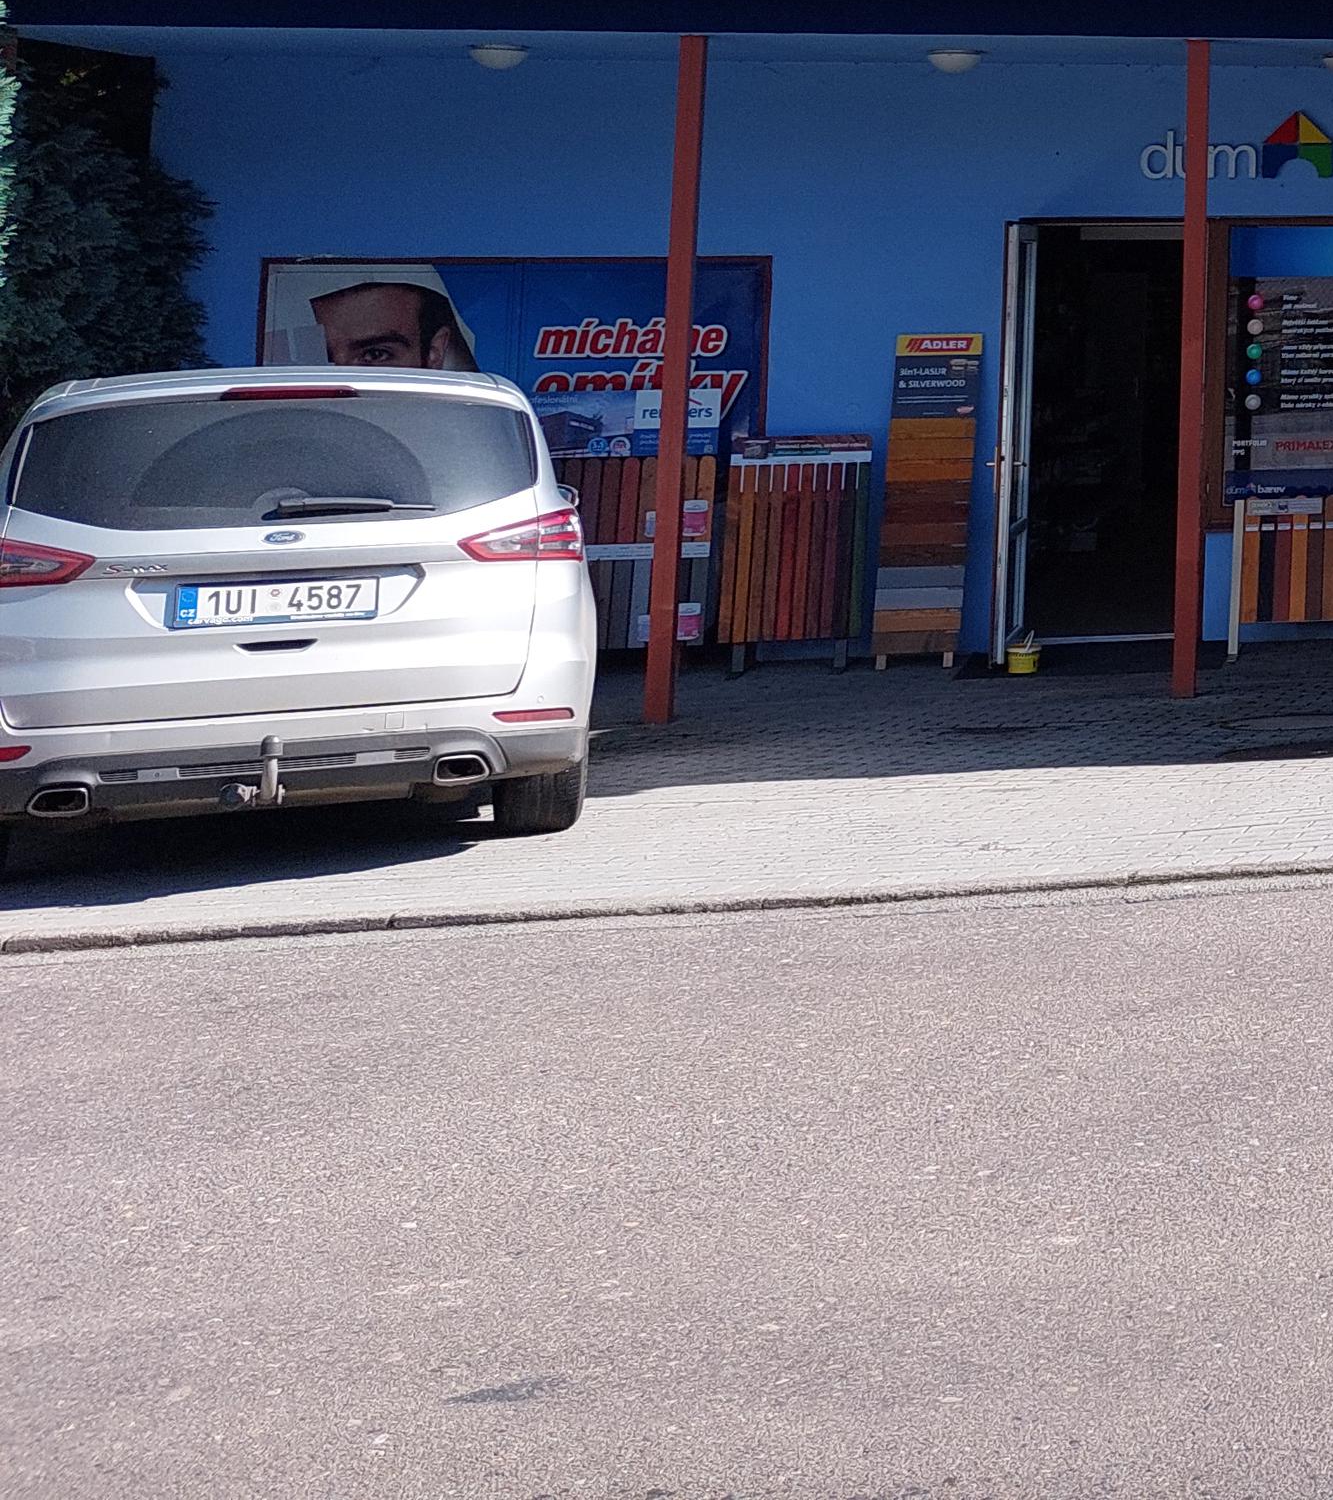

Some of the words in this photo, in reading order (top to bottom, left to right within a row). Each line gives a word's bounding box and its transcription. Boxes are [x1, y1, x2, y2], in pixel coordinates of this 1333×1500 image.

[1141, 131, 1258, 180] dm
[535, 318, 727, 357] mícháe
[920, 340, 968, 349] ADLER
[898, 379, 906, 388] &
[908, 379, 966, 388] SILVERWOOD
[641, 406, 712, 419] reers
[1257, 484, 1286, 494] barev
[207, 588, 257, 616] 1UI
[287, 583, 362, 612] 4587
[180, 608, 196, 618] CZ
